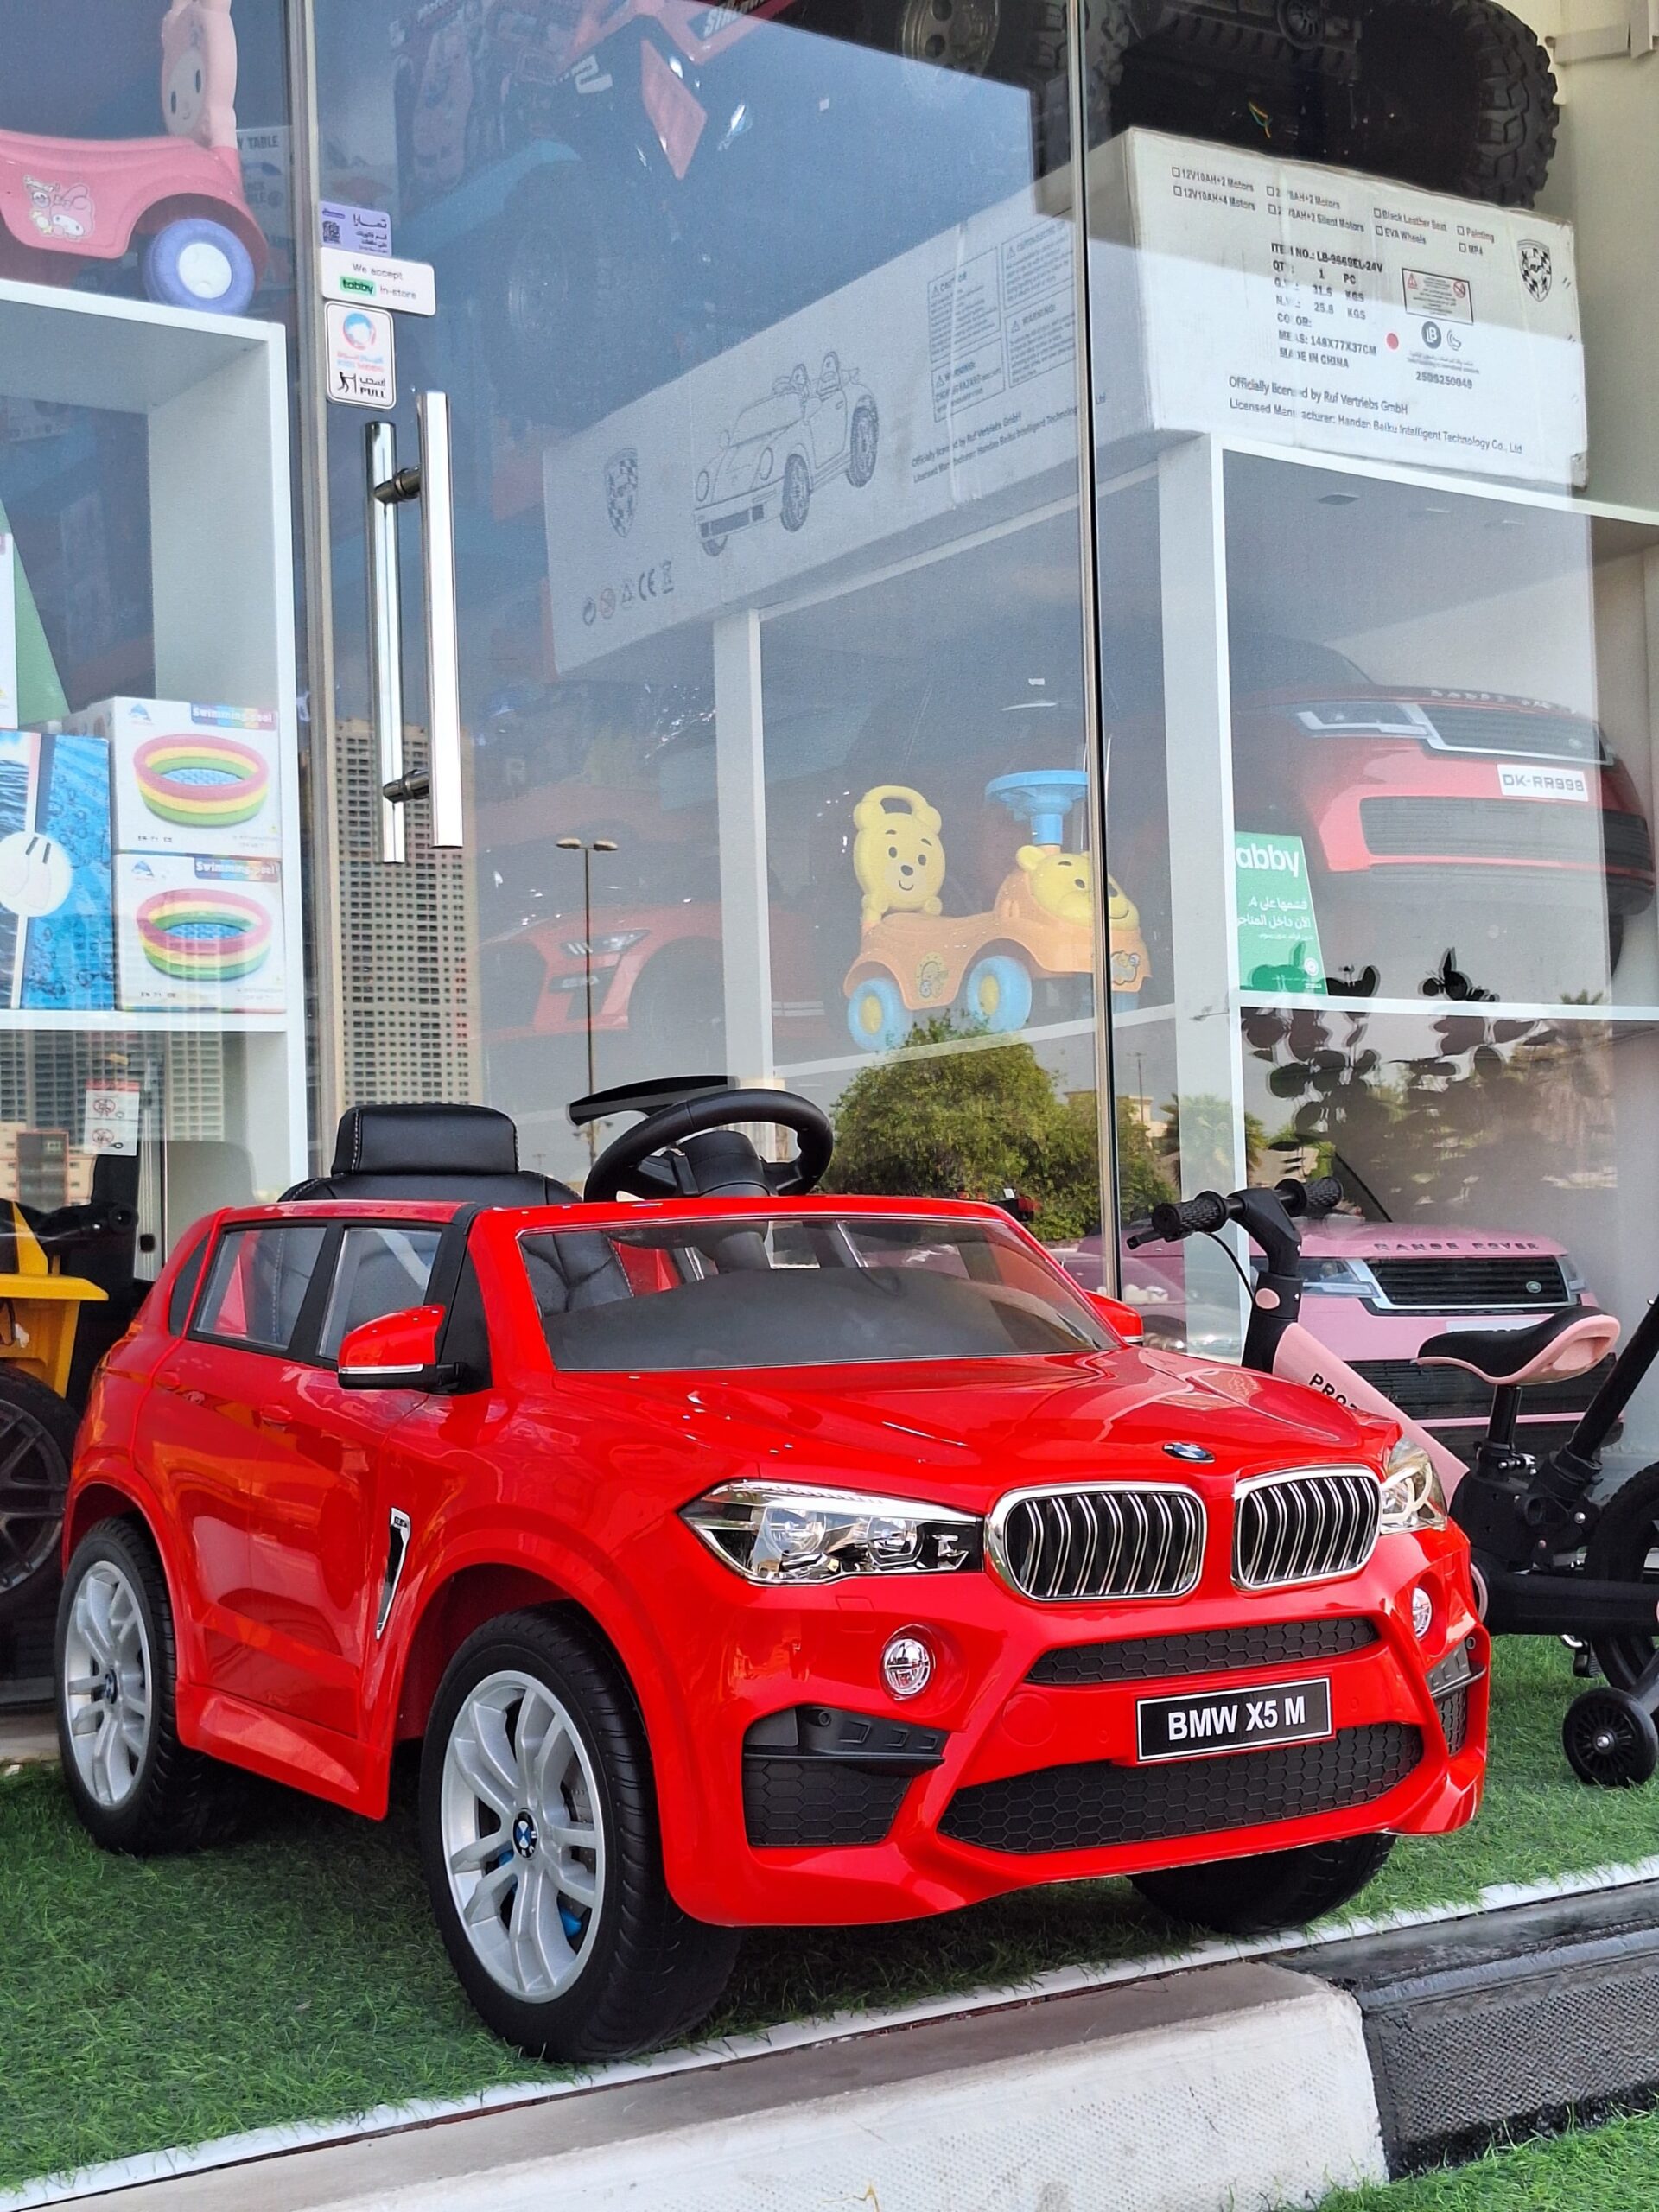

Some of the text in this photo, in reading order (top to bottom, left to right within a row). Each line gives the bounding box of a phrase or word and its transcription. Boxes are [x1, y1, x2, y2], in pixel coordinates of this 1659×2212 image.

[1227, 179, 1254, 192] Motors
[1230, 197, 1255, 211] Motors
[1384, 227, 1400, 239] EVA
[353, 263, 367, 273] We
[1273, 260, 1294, 274] QT:
[1277, 313, 1312, 327] COOR:
[1308, 353, 1319, 363] IN
[360, 387, 386, 398] PULL
[1229, 376, 1269, 395] Officially
[1311, 387, 1322, 404] by
[1324, 391, 1338, 403] Ruf
[1381, 400, 1408, 415] GmbH
[1230, 398, 1271, 414] Licensed
[1400, 424, 1441, 442] Intelligent
[1443, 430, 1491, 450] Technology
[1236, 842, 1300, 878] abby
[1168, 1696, 1305, 1741] BMW X5 M
